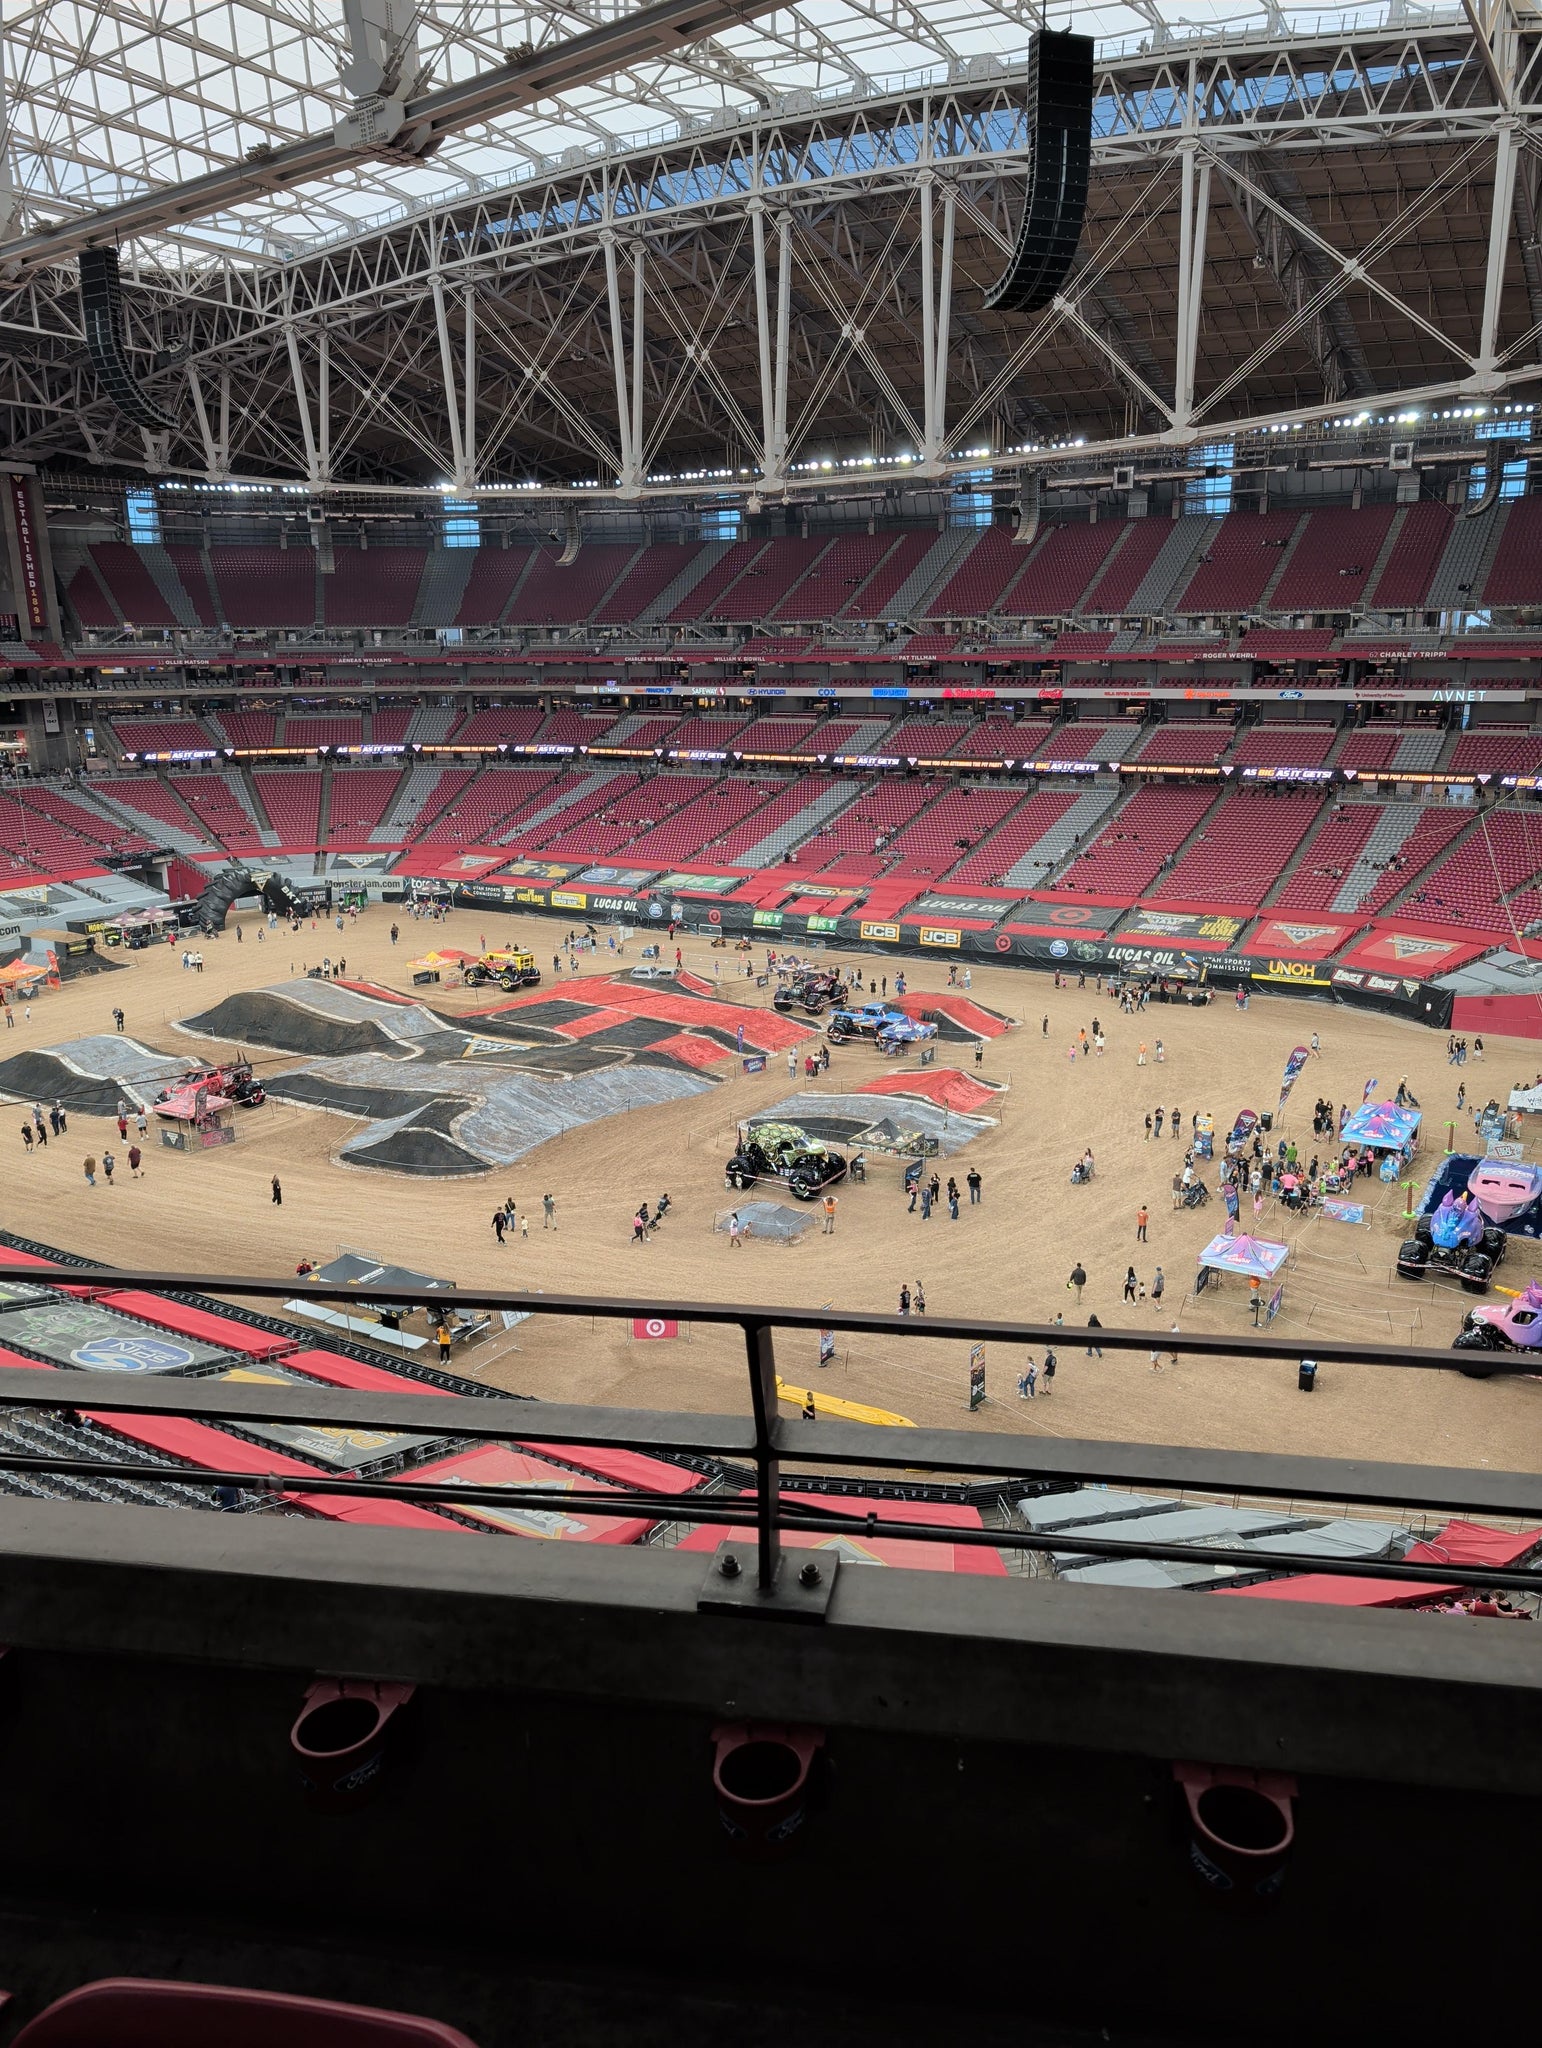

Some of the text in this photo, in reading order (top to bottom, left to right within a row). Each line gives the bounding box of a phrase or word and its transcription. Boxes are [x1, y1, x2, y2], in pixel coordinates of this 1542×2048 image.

[17, 491, 41, 623] ESTABLISHED 1898
[818, 688, 836, 696] COX
[1282, 690, 1302, 698] Ford
[1432, 690, 1487, 701] AVNET
[1276, 769, 1289, 777] AS
[1302, 770, 1333, 778] GETS!
[1501, 777, 1516, 785] AS
[1517, 778, 1535, 786] BIG
[325, 879, 401, 889] MonsterJam.com
[280, 885, 302, 905] BKT
[593, 897, 621, 910] LUCAS
[919, 899, 1009, 913] LUCAS OIL
[754, 911, 782, 924] BKT
[808, 917, 837, 930] BKT
[864, 926, 896, 938] JCB
[1198, 927, 1235, 937] GAME
[1205, 922, 1240, 931] VIDEO
[923, 931, 958, 944] JCB
[1107, 946, 1152, 961] LUCAS
[1205, 963, 1251, 973] OMMISSION
[1224, 958, 1251, 966] SPORTS
[1268, 959, 1316, 976] UNOH
[111, 1342, 167, 1364] SPIN
